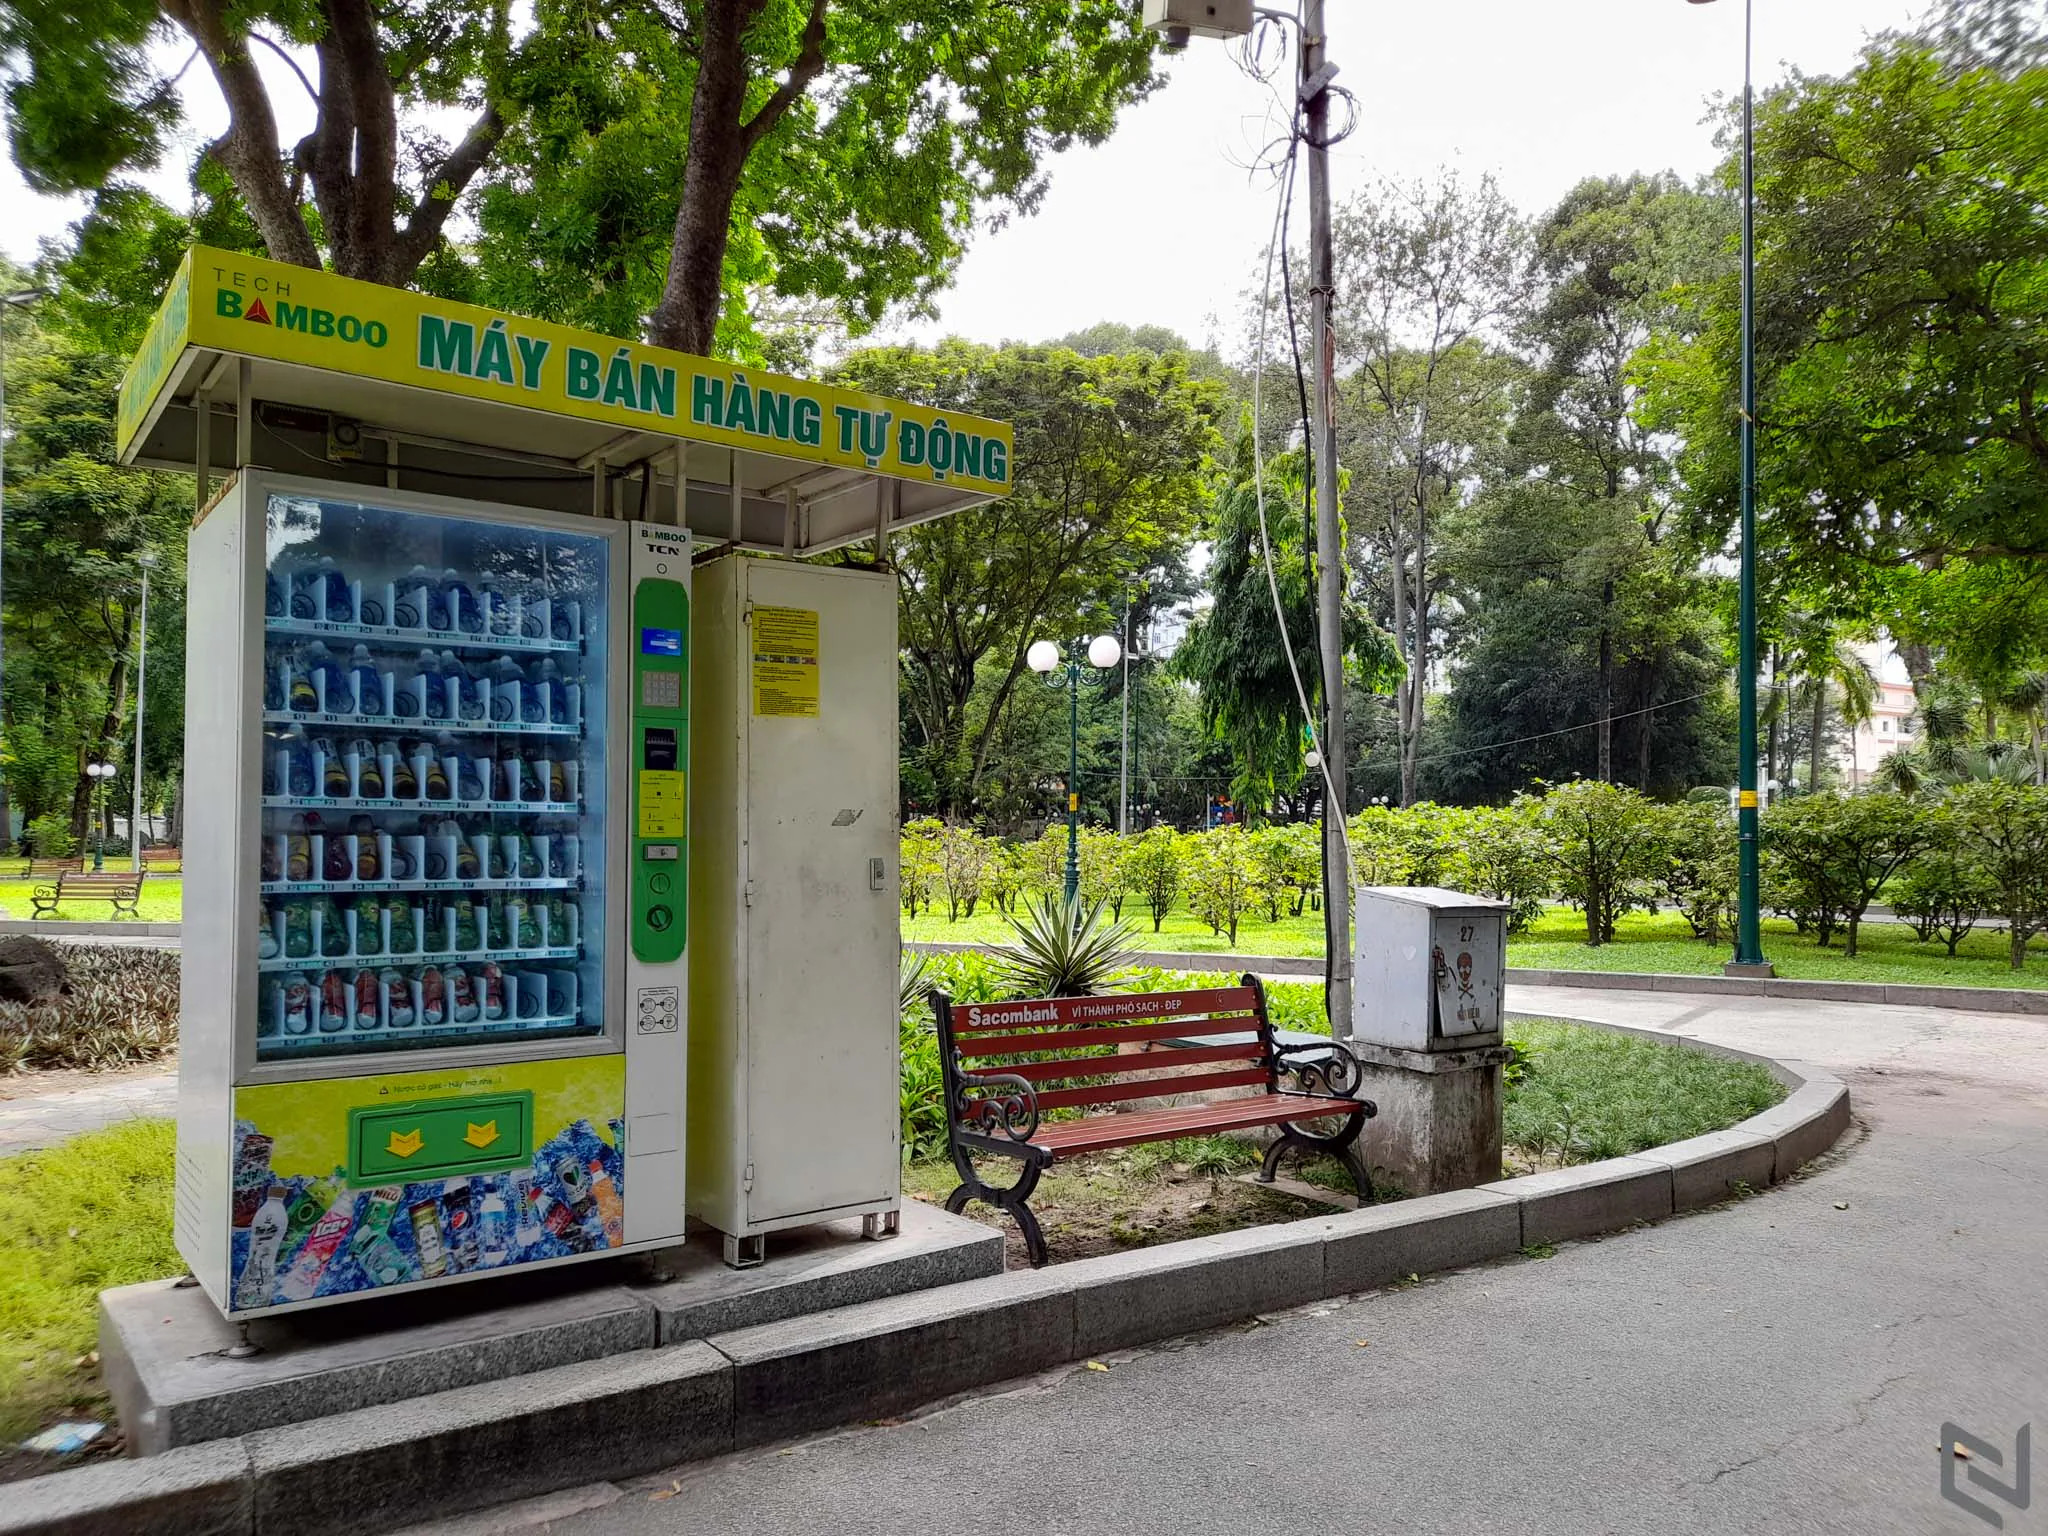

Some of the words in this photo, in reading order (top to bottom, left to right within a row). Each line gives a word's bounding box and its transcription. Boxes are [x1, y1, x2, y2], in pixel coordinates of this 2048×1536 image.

[212, 267, 291, 297] TECH
[216, 288, 389, 349] BAMBOO
[418, 313, 552, 392] MÁY
[565, 345, 678, 419] BÁN
[690, 373, 822, 447] HÀNG
[833, 404, 892, 467] TỰ
[898, 417, 1008, 483] ĐỘNG
[645, 543, 680, 556] TCN
[1460, 925, 1474, 942] 27
[968, 1003, 1059, 1027] Sacombank
[1072, 1005, 1081, 1018] VÌ
[1083, 1003, 1114, 1017] THÀNH
[1136, 1001, 1159, 1015] SẠCH
[1165, 999, 1182, 1012] ĐẸP
